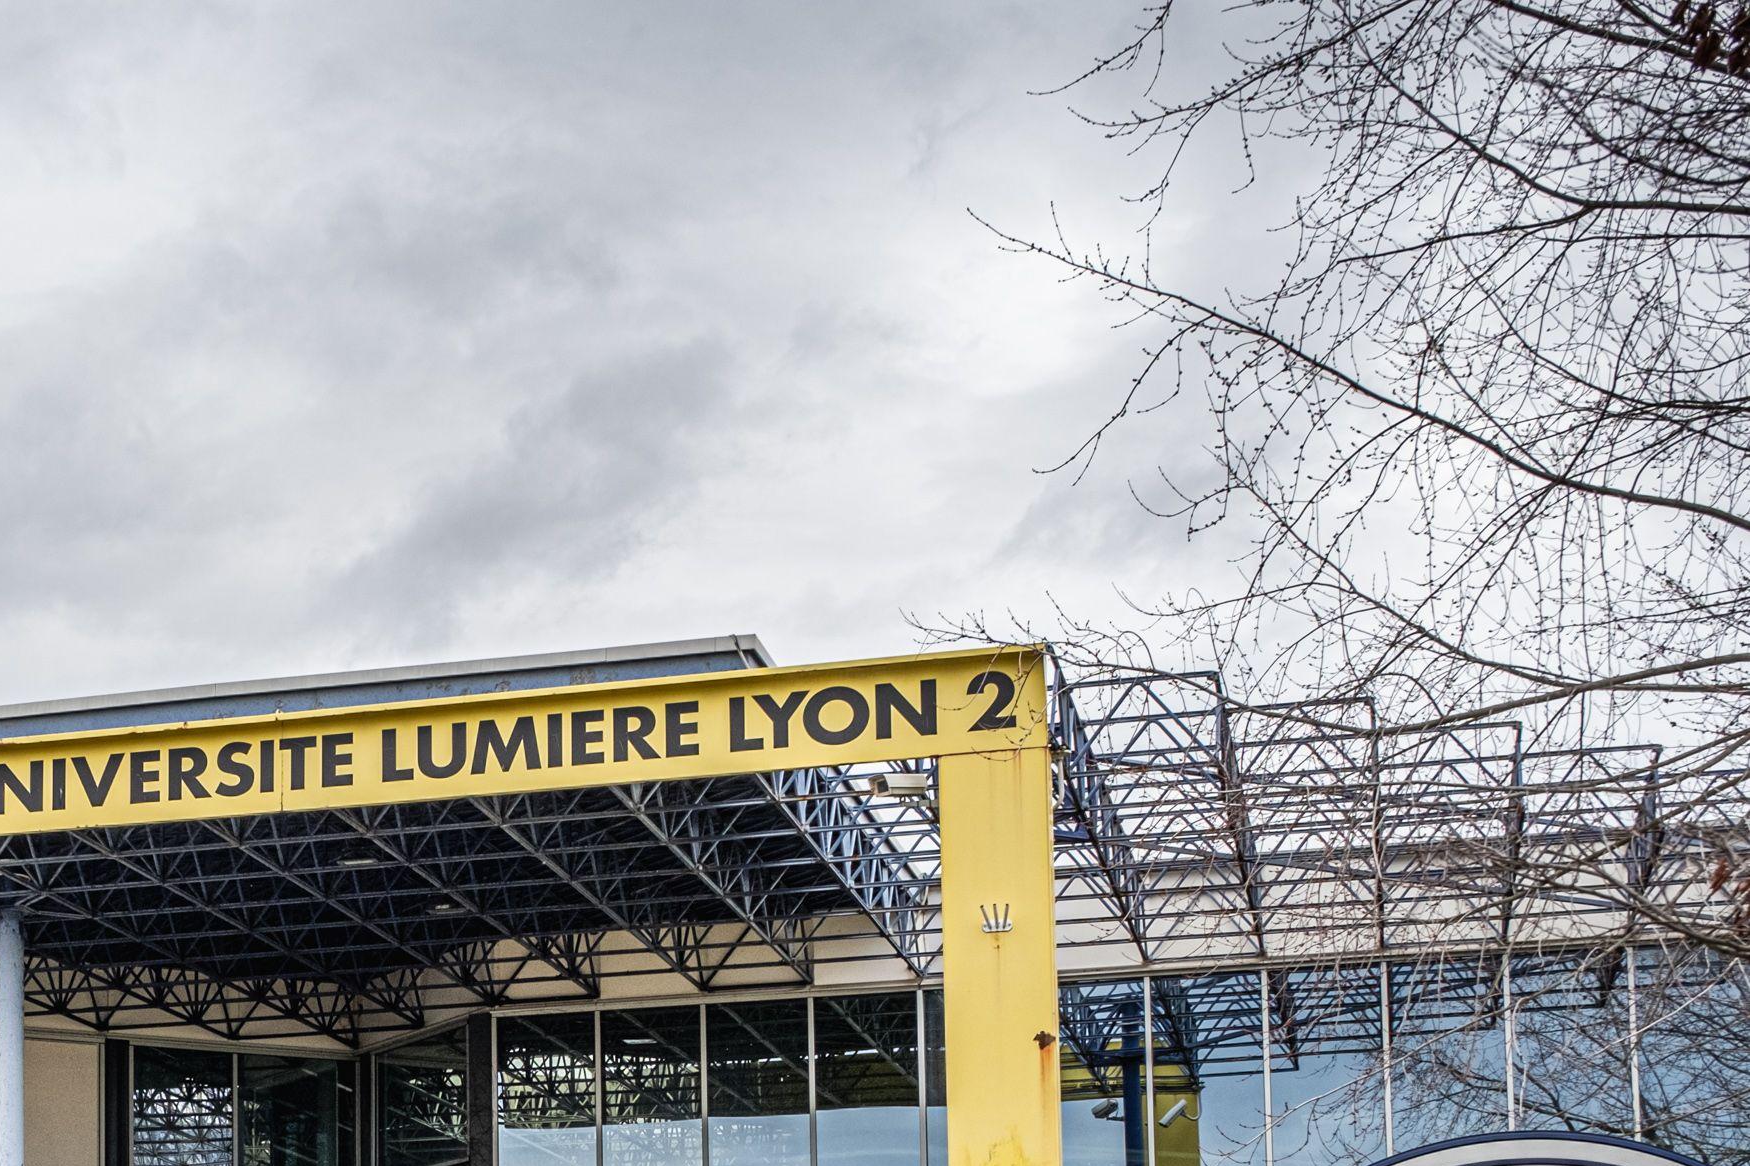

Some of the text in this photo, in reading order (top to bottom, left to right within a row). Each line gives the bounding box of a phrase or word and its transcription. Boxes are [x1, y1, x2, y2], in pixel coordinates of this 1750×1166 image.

[381, 700, 700, 783] LUMIERE
[729, 678, 938, 753] LYON
[966, 671, 1017, 733] 2
